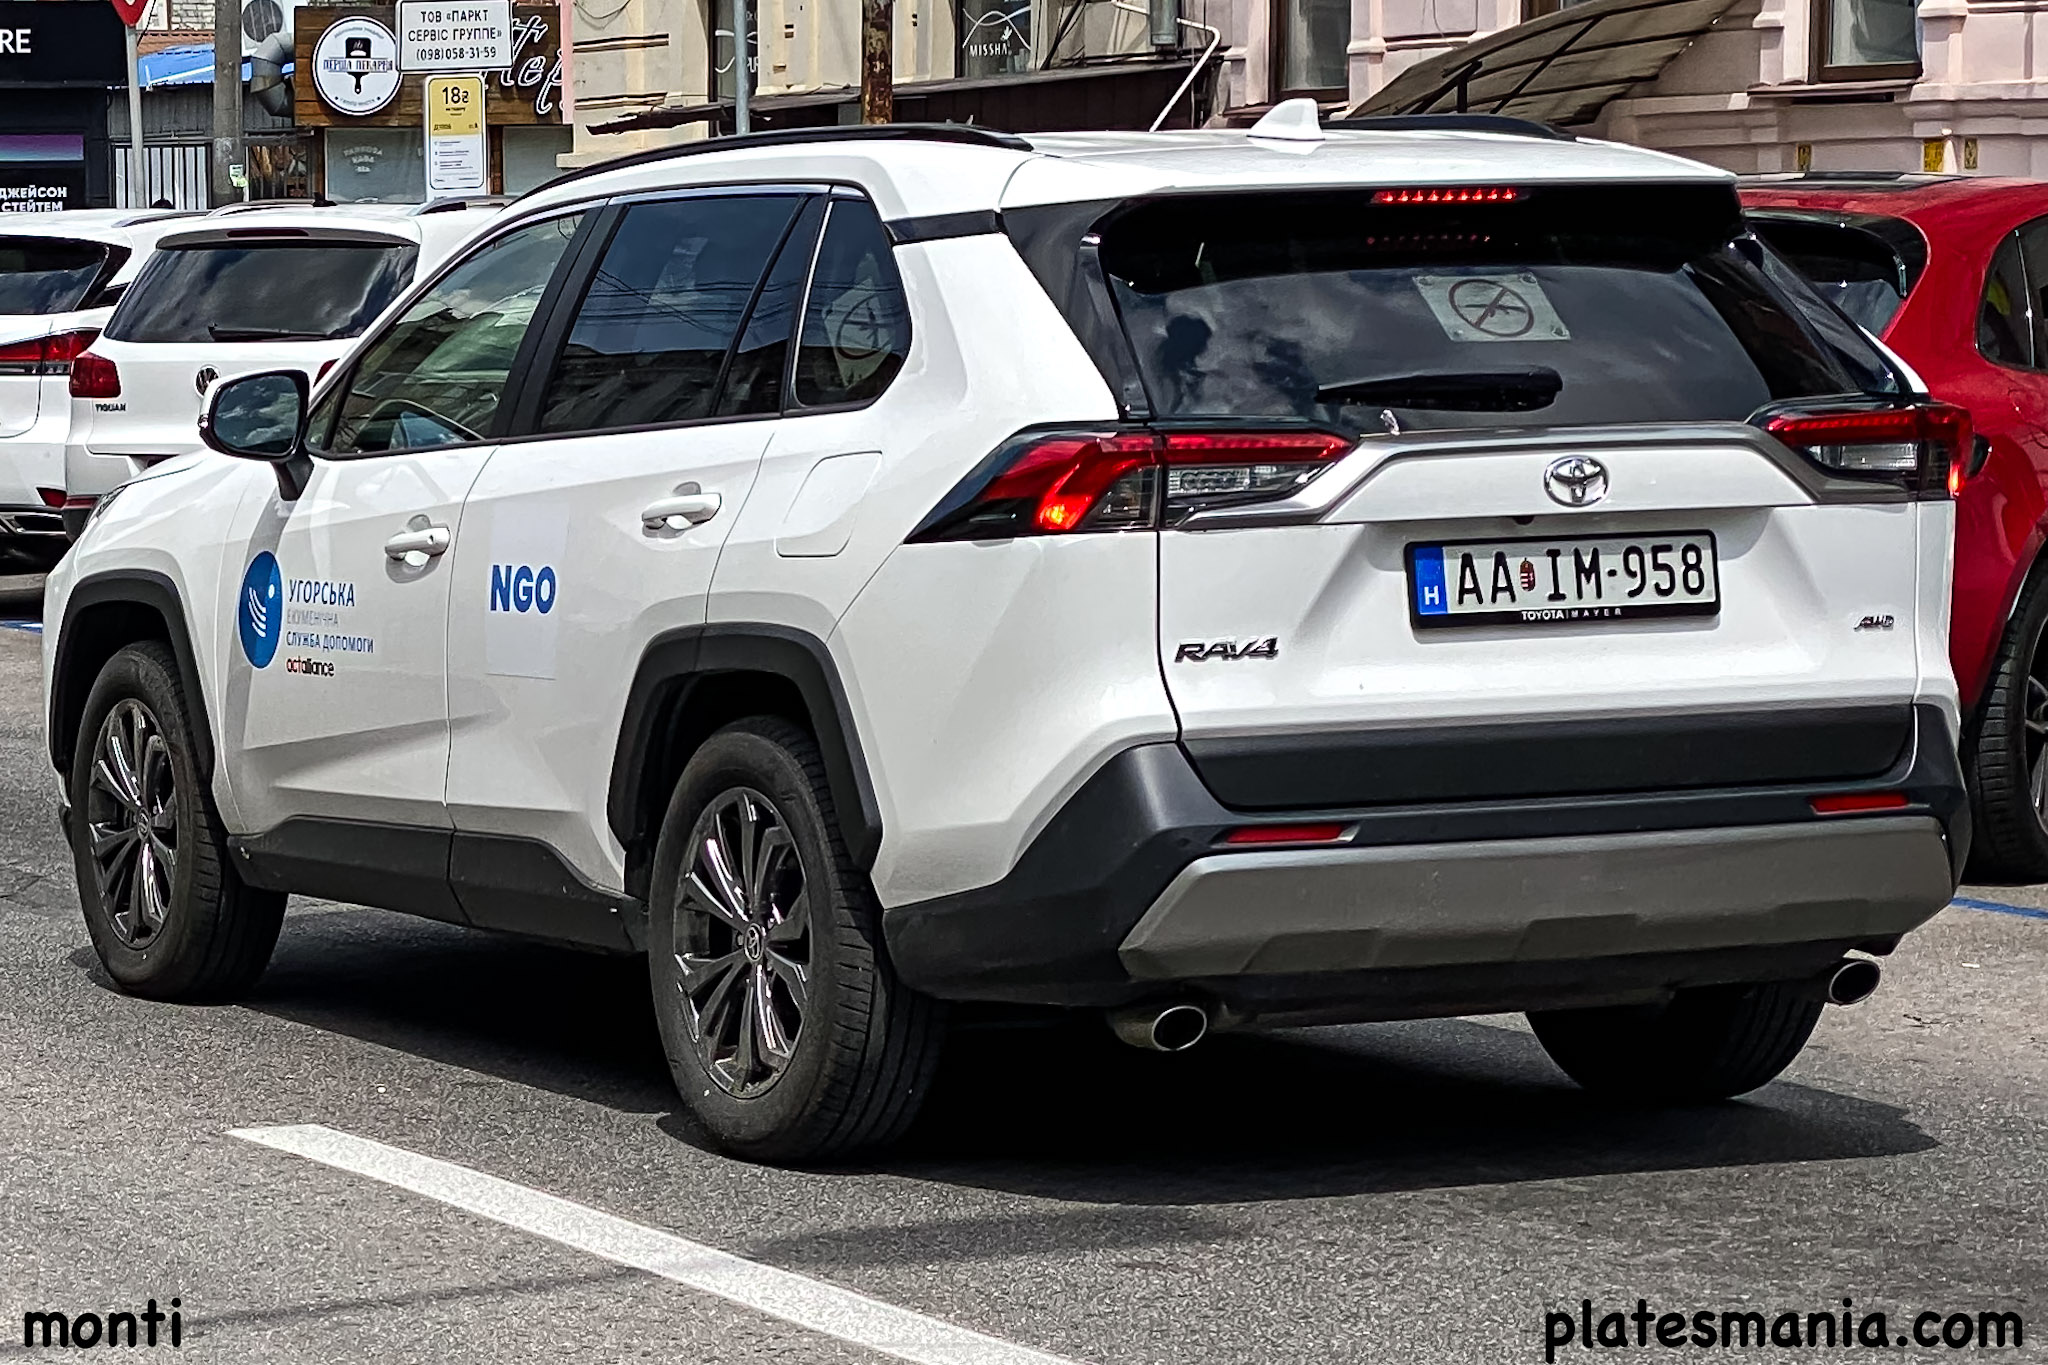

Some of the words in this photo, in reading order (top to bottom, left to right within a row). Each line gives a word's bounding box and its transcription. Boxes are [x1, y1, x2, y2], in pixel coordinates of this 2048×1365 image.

[421, 11, 442, 23] ТОВ
[446, 10, 488, 22] «ПАРКТ
[408, 29, 448, 41] СЕРВІС
[416, 46, 496, 61] (098)058-31-59
[970, 43, 1007, 57] MISSHA
[0, 184, 67, 200] ДЖЕЙСОН
[1, 199, 63, 212] СТЕЙТЕМ
[1424, 586, 1440, 606] H
[1457, 551, 1517, 605] AA
[1545, 543, 1705, 602] IM-958
[288, 579, 355, 607] УГОРСЬКА
[490, 564, 556, 614] NGO
[1521, 610, 1565, 621] TOYOTA
[1570, 607, 1621, 619] MAYER
[286, 630, 321, 649] СЛУЖБА
[322, 634, 374, 654] ДОПОМОГИ
[1174, 636, 1278, 663] RAV4
